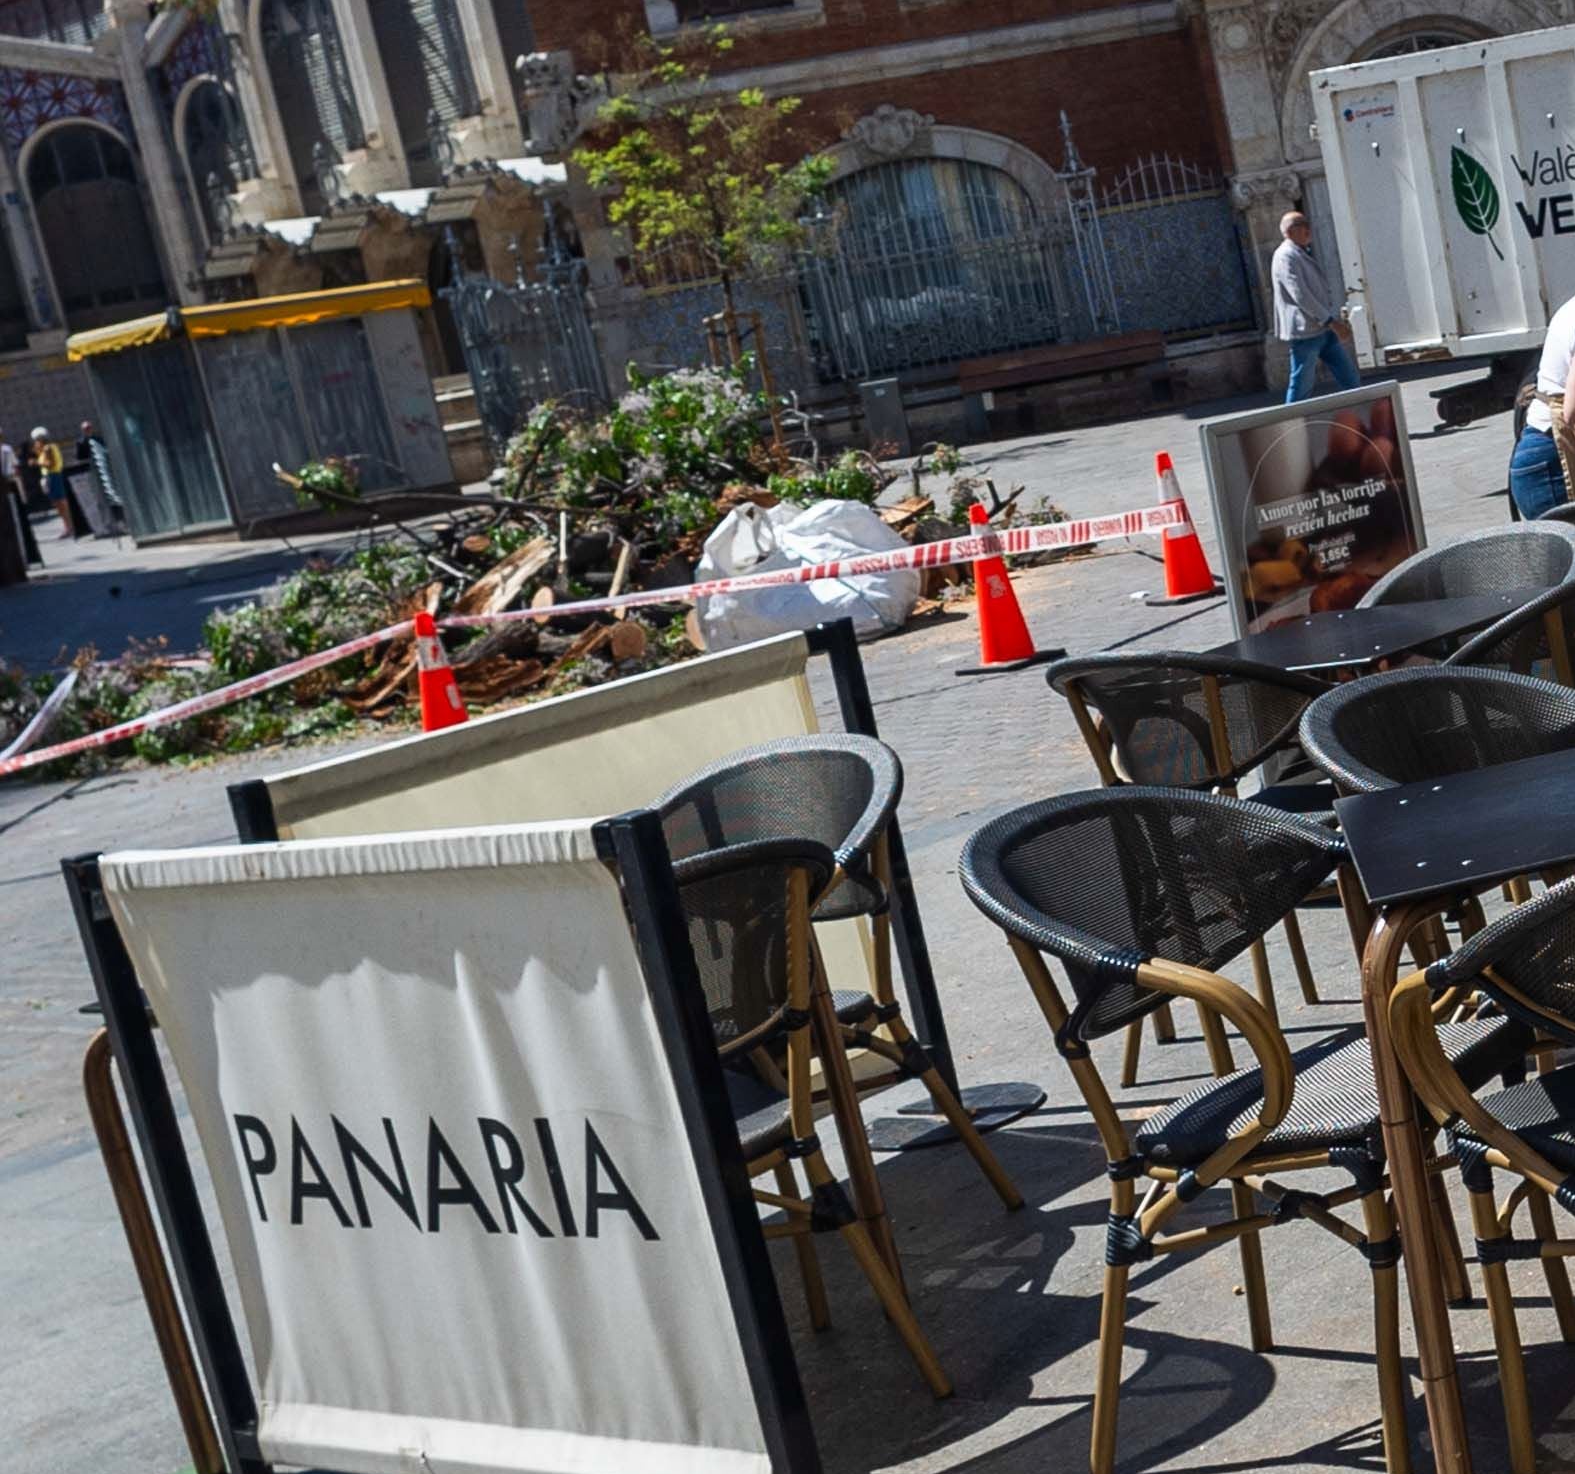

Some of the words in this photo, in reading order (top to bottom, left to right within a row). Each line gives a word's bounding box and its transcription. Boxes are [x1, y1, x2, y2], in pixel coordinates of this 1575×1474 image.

[1258, 503, 1294, 525] Amor
[1295, 496, 1320, 515] por
[1319, 488, 1341, 508] las
[1342, 478, 1387, 501] torrijas
[1327, 503, 1371, 527] hechas
[233, 1113, 660, 1241] PANARIA
